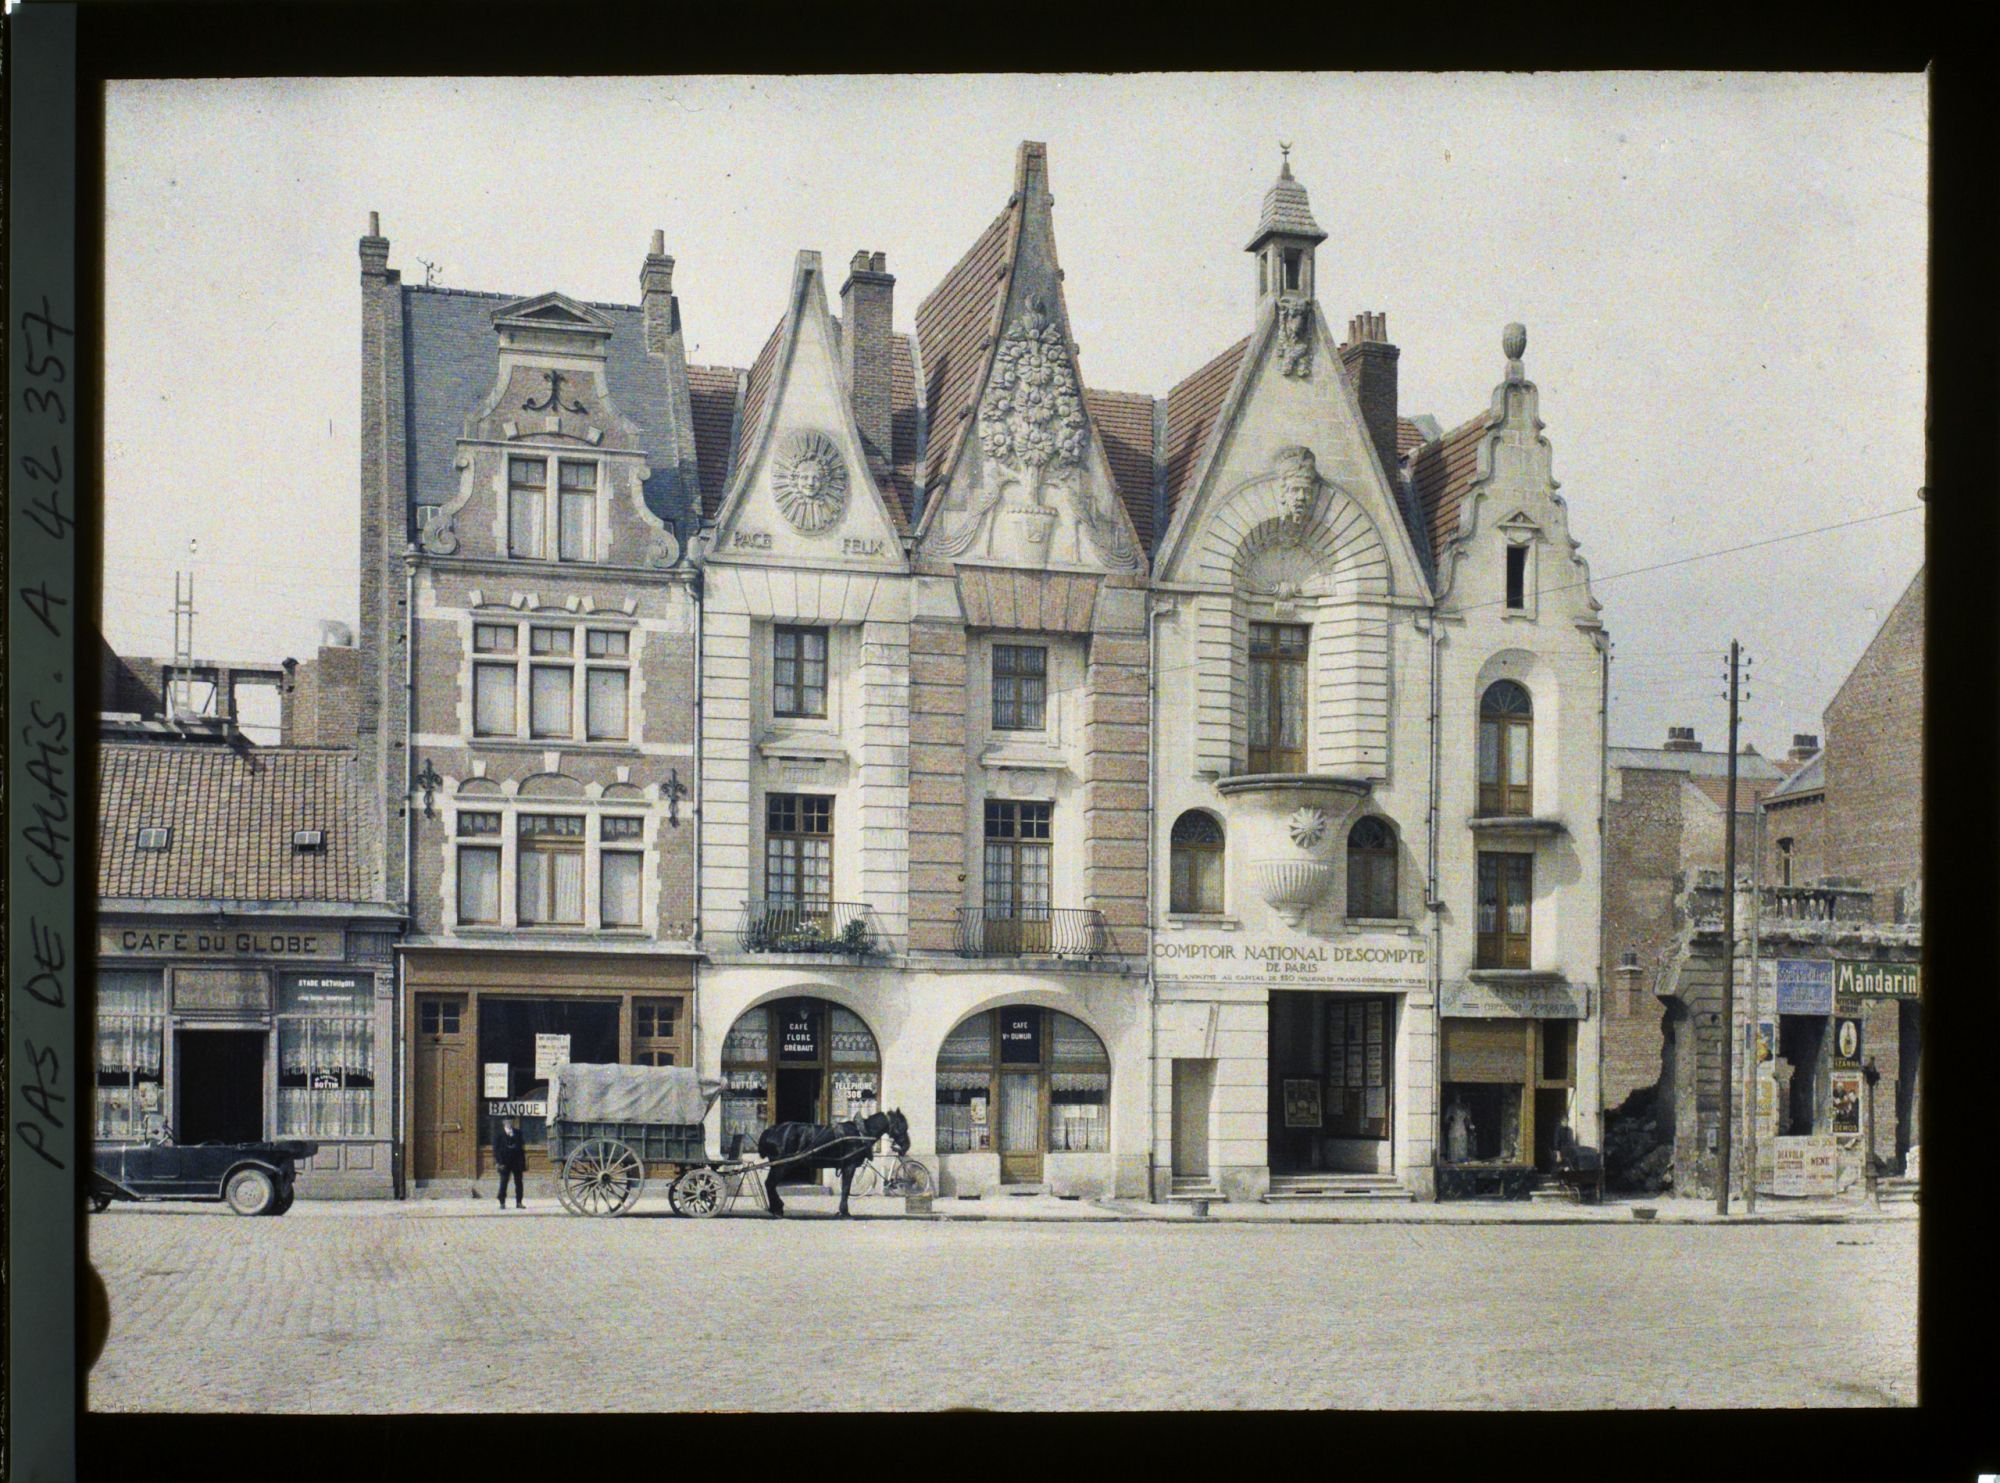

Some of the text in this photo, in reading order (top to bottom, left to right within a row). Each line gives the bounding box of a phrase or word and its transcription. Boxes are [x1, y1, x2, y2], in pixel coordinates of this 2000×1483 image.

[843, 538, 884, 554] FELIX
[20, 581, 68, 638] A
[198, 935, 225, 951] DU
[236, 933, 317, 953] GLOBE
[1153, 943, 1237, 960] COMPTOIR
[1244, 945, 1328, 961] NATIONAL
[23, 915, 66, 1009] DE
[1266, 962, 1318, 973] DE PARIS
[1838, 964, 1917, 993] Mandarin
[16, 1038, 66, 1170] PAS
[491, 1102, 541, 1116] BANQUE
